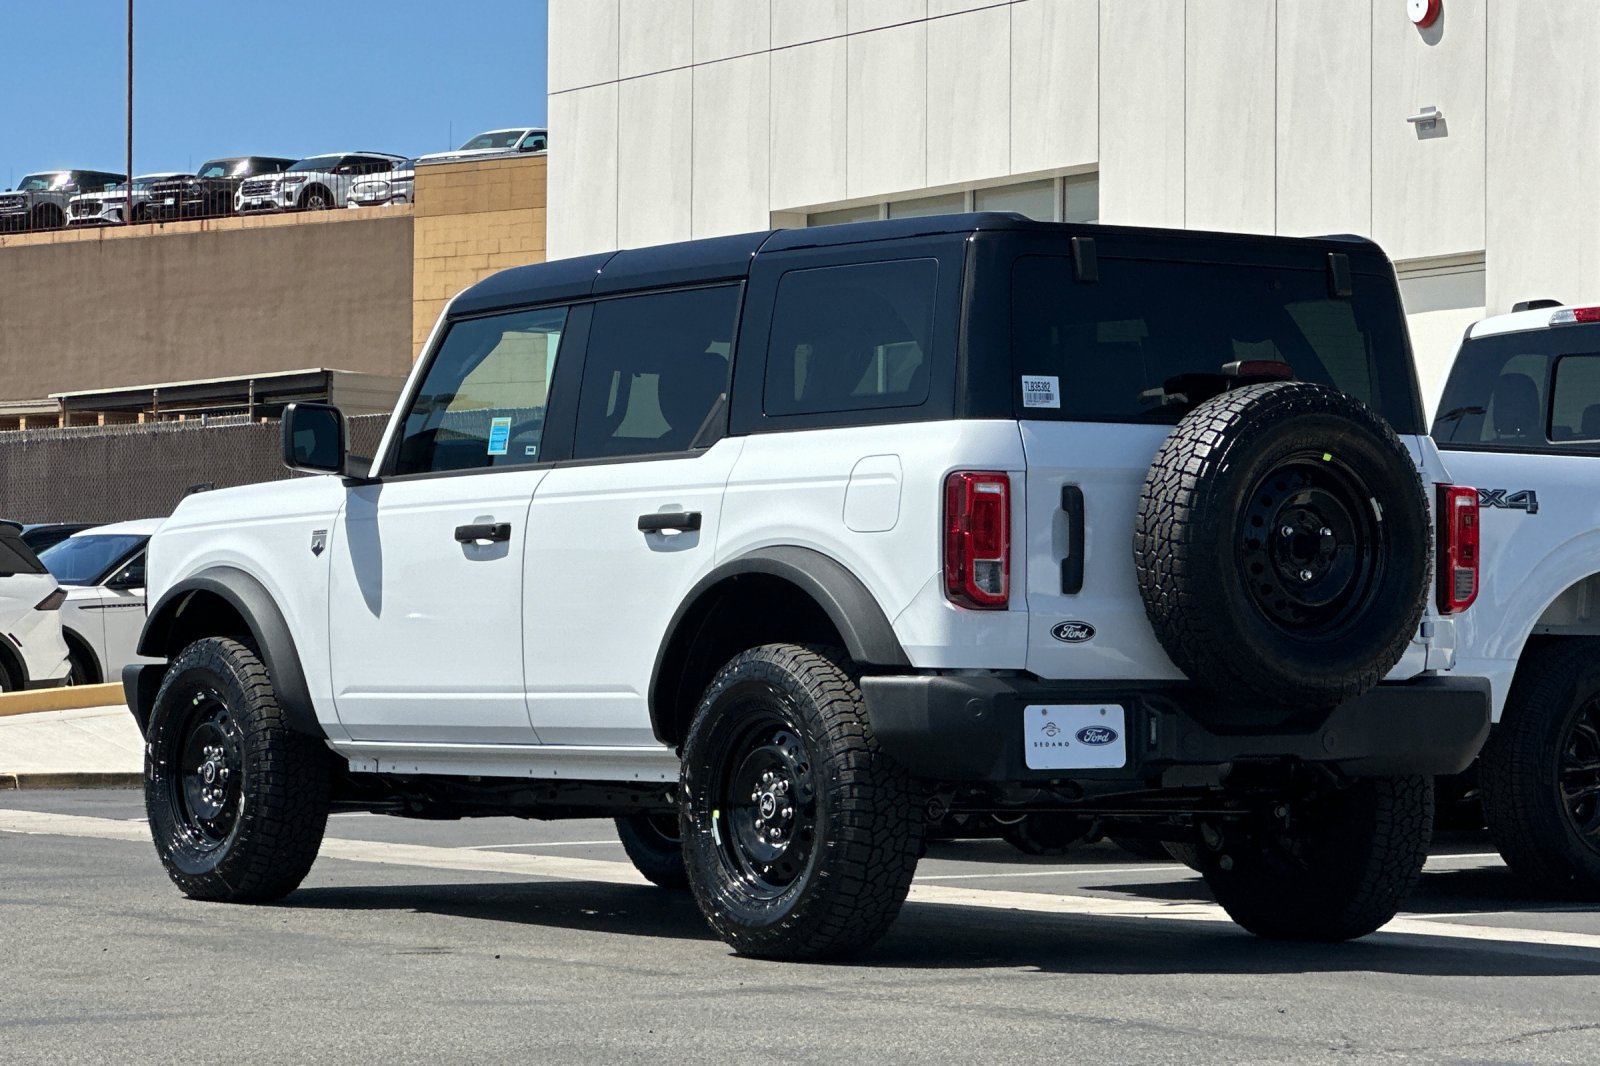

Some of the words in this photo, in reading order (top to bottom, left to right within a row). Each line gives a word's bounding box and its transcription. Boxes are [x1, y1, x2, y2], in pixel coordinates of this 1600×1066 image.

[1477, 488, 1539, 514] X4
[1060, 624, 1088, 638] Ford
[1084, 728, 1109, 742] Ford
